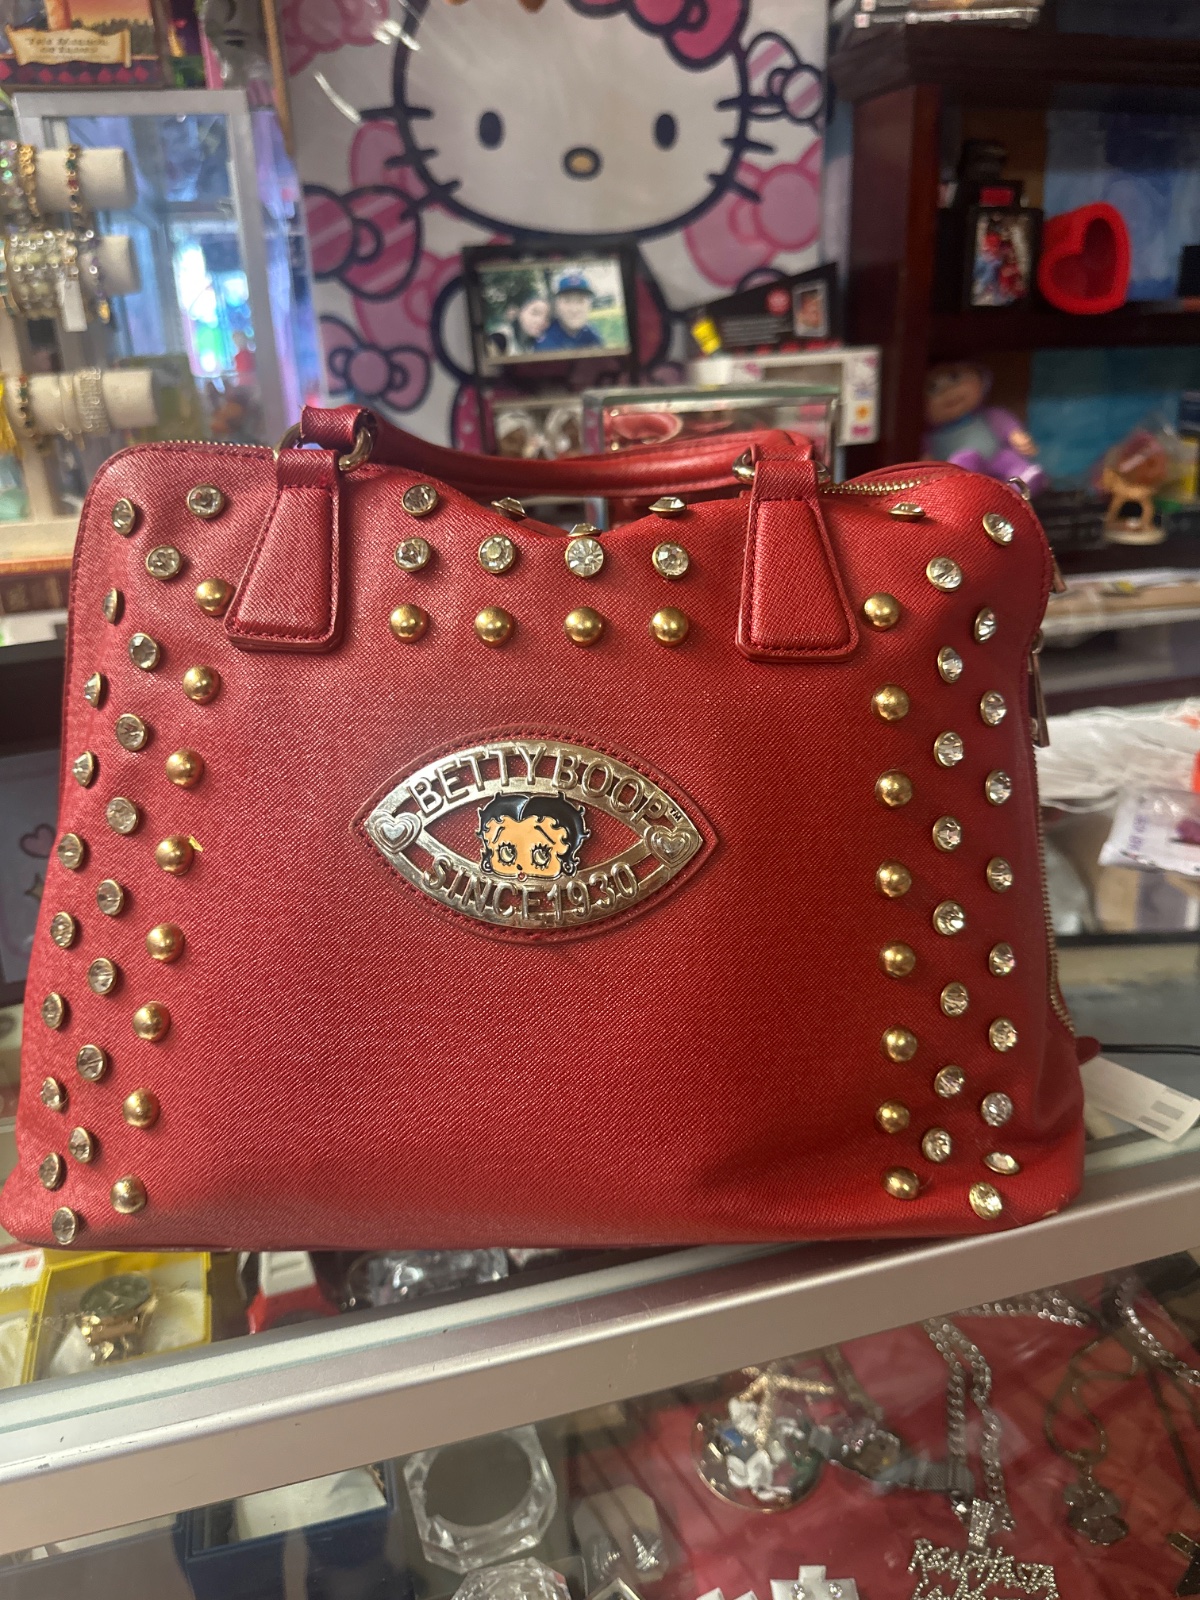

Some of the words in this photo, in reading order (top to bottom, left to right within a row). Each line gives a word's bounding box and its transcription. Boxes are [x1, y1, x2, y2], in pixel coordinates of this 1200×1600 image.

[407, 742, 548, 817] BETTY
[550, 752, 670, 826] BOOP
[420, 854, 542, 924] SINCE
[545, 861, 641, 922] 1930
